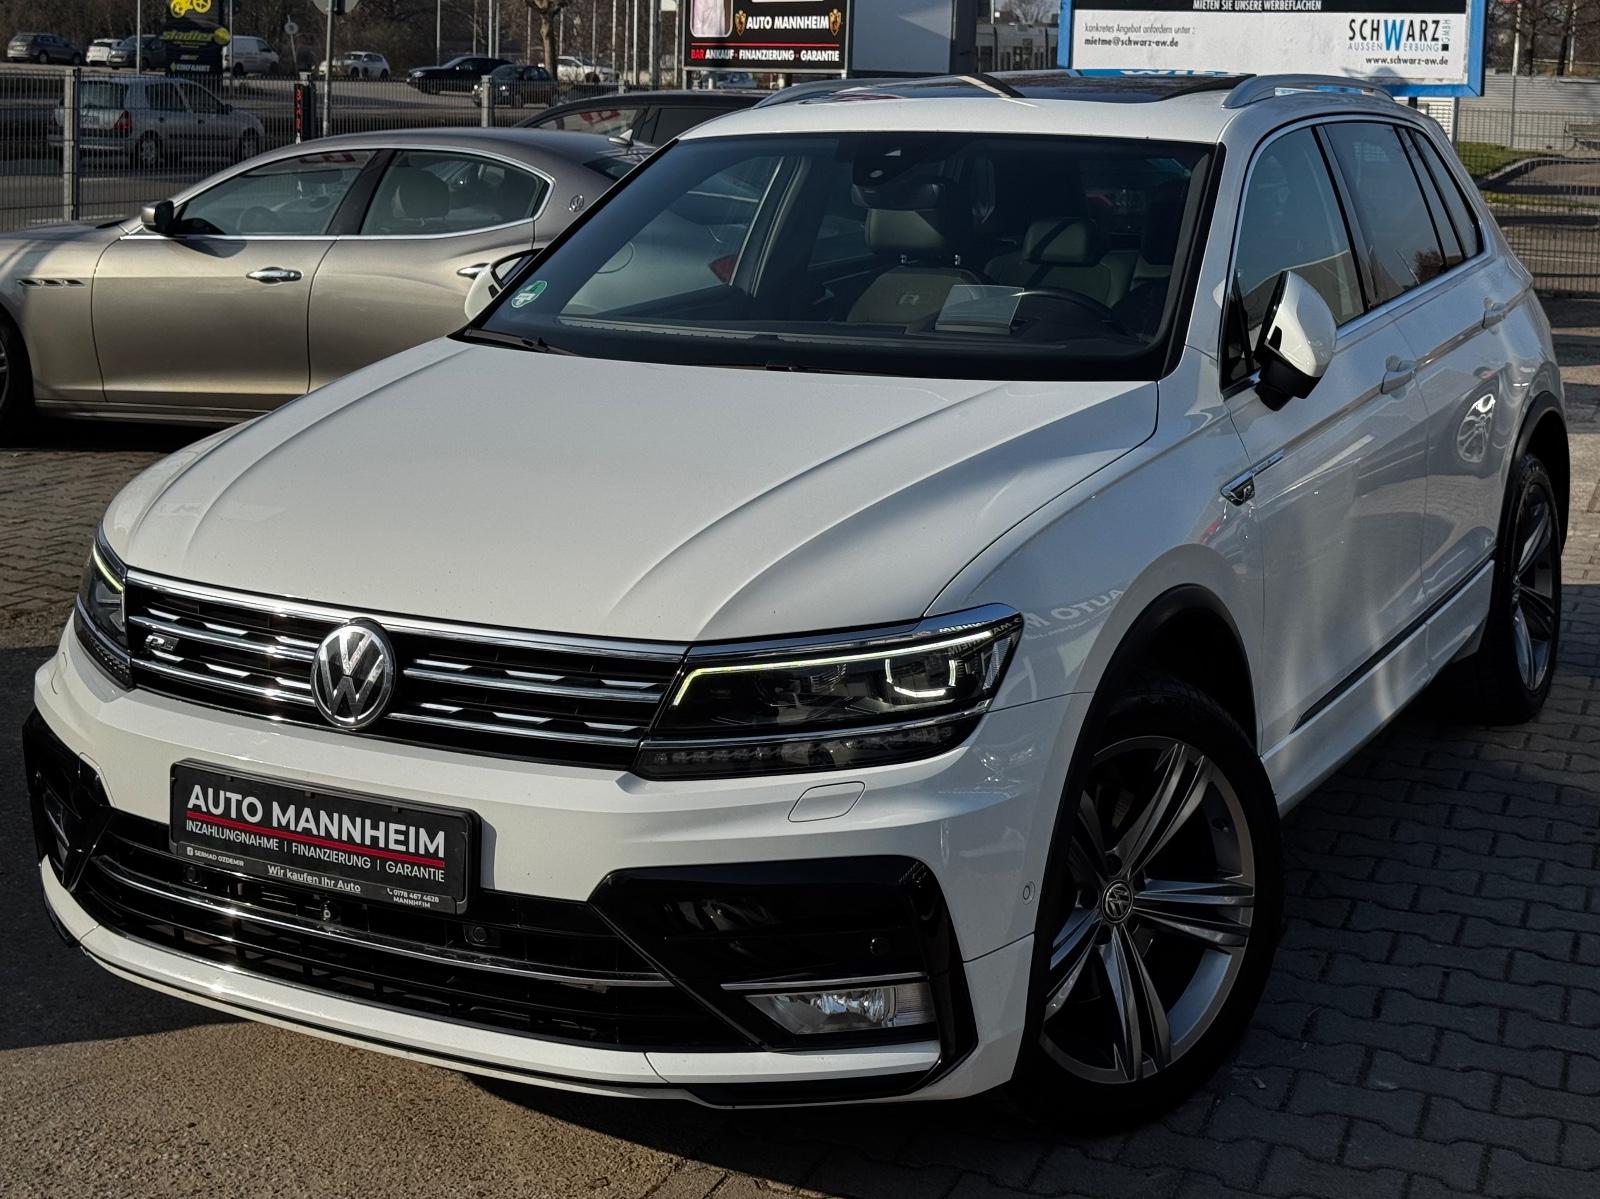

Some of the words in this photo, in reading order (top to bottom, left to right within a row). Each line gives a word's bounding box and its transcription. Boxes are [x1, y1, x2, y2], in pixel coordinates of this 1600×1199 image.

[1192, 0, 1220, 9] MIETEN
[1221, 0, 1233, 10] SIE
[1235, 0, 1262, 10] UNSERE
[746, 16, 773, 29] AUTO
[774, 16, 829, 29] MANNHEIM
[1085, 22, 1115, 33] konkretes
[1116, 24, 1142, 35] Angebot
[1143, 24, 1173, 34] anfordern
[1174, 26, 1190, 35] unter
[1348, 19, 1440, 51] SCHWARZ
[1084, 36, 1179, 48] mietme@schwarz-aw.de
[705, 49, 734, 60] ANKAUF
[739, 49, 794, 61] FINANZIERUNG
[800, 50, 840, 61] GARANTIE
[1365, 55, 1449, 66] www.schwarz-aw.de
[187, 784, 263, 824] AUTO
[272, 801, 445, 858] MANNHEIM
[186, 820, 279, 851] INZAHLUNGNAHME
[292, 842, 371, 869] FINANZIERUNG
[385, 861, 445, 883] GARANTIE
[267, 865, 284, 877] Wir
[286, 869, 319, 885] kaufen
[321, 877, 335, 888] Ihr
[337, 880, 361, 892] Auto
[393, 896, 430, 908] MANNHEIM
